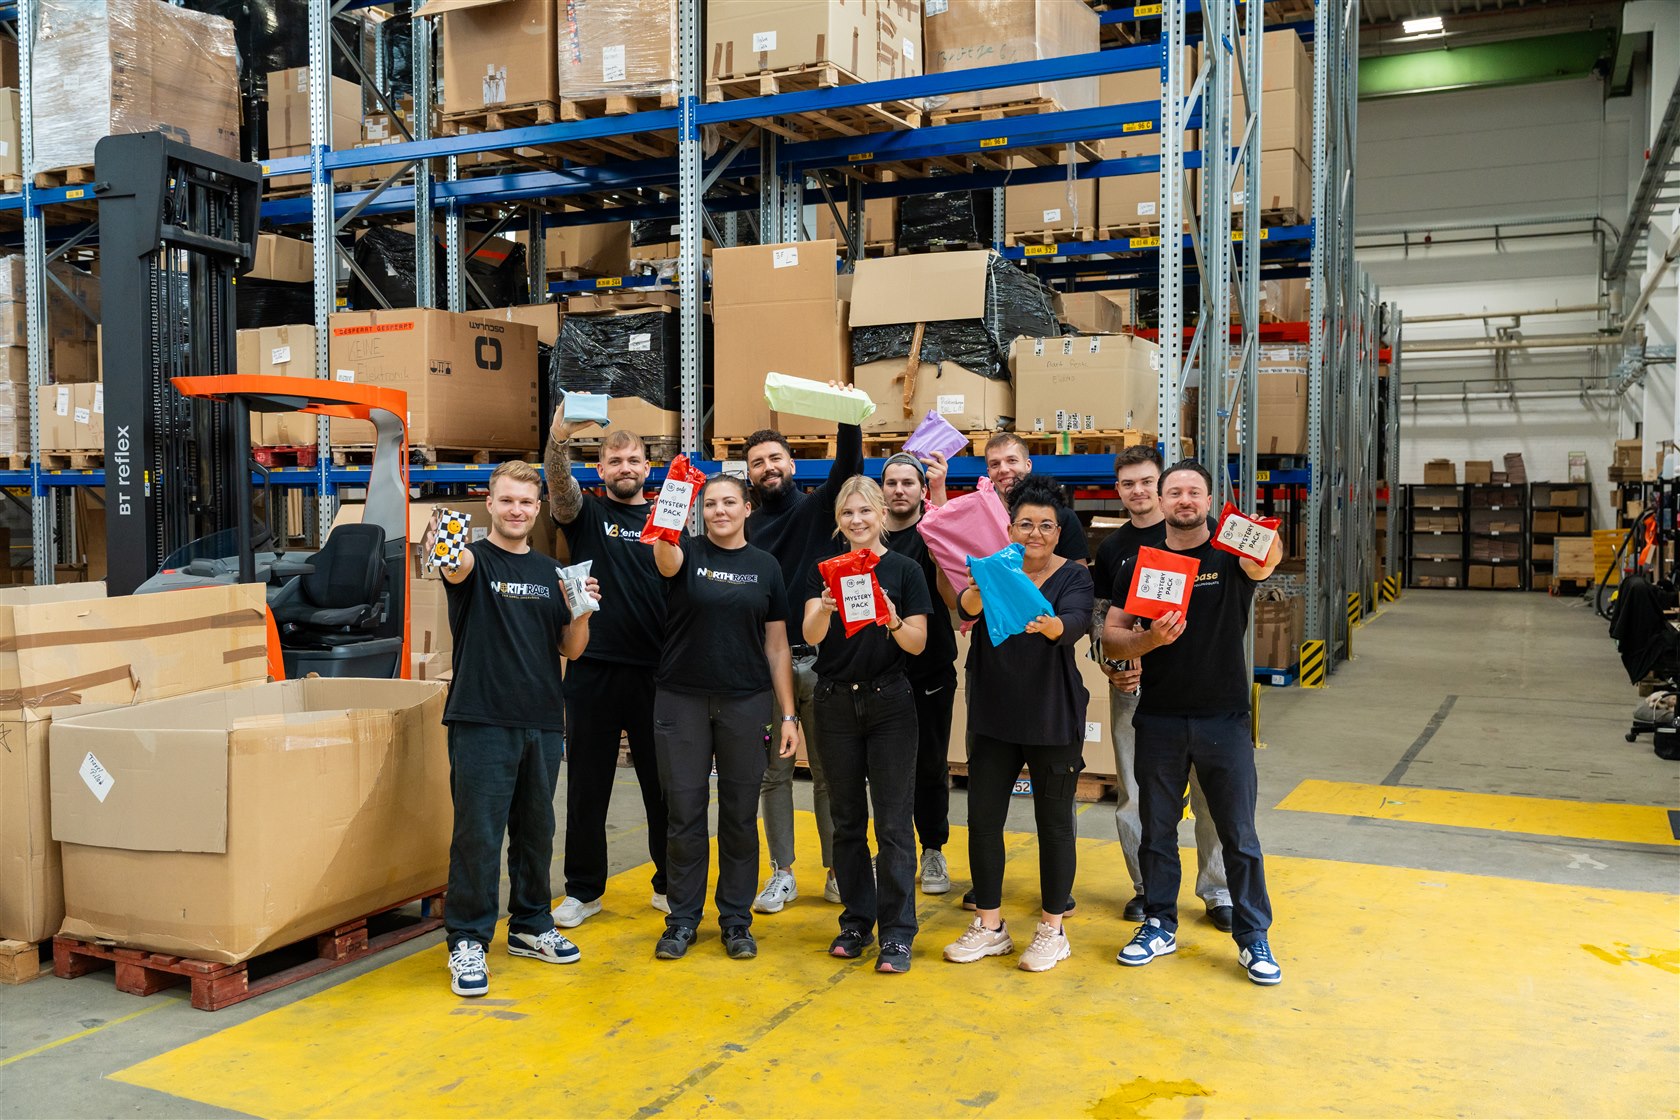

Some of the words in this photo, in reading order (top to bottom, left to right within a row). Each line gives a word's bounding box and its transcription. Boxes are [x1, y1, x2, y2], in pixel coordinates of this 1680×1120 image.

[469, 321, 505, 333] OSCULATI
[114, 425, 131, 486] reflex
[119, 492, 131, 516] BT
[659, 499, 688, 509] MYSTERY
[663, 508, 682, 517] PACK
[1238, 523, 1255, 550] MYSTERY
[1248, 532, 1261, 549] PACK
[1156, 572, 1167, 600] MYSTERY
[1165, 577, 1174, 596] PACK
[844, 593, 872, 603] MYSTERY
[1014, 781, 1030, 793] 52
